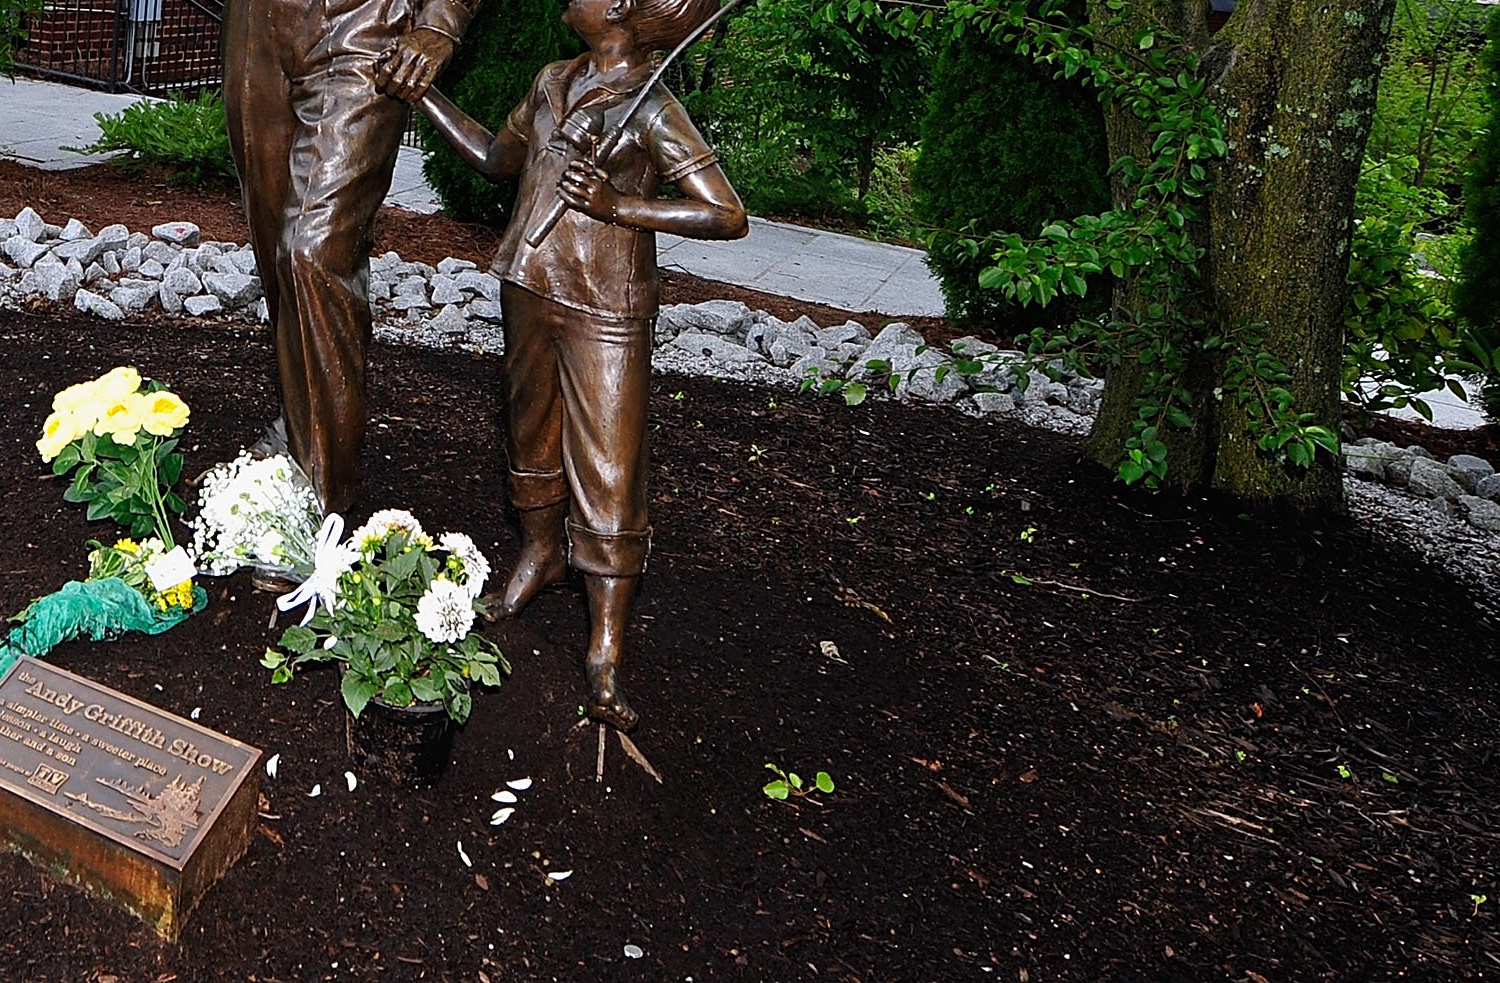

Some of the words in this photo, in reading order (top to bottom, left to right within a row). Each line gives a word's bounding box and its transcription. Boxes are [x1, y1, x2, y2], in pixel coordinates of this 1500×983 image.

[18, 671, 36, 685] the
[24, 681, 85, 715] Andy
[6, 700, 48, 723] simpler
[49, 718, 75, 735] time
[81, 733, 90, 742] a
[90, 736, 137, 762] sweeter
[133, 755, 168, 776] place
[39, 730, 47, 739] a
[48, 732, 82, 754] laugh
[84, 703, 167, 750] Griffith
[23, 736, 47, 752] and
[46, 747, 54, 756] a
[55, 751, 77, 766] son
[167, 738, 234, 776] Show
[38, 766, 66, 785] TV
